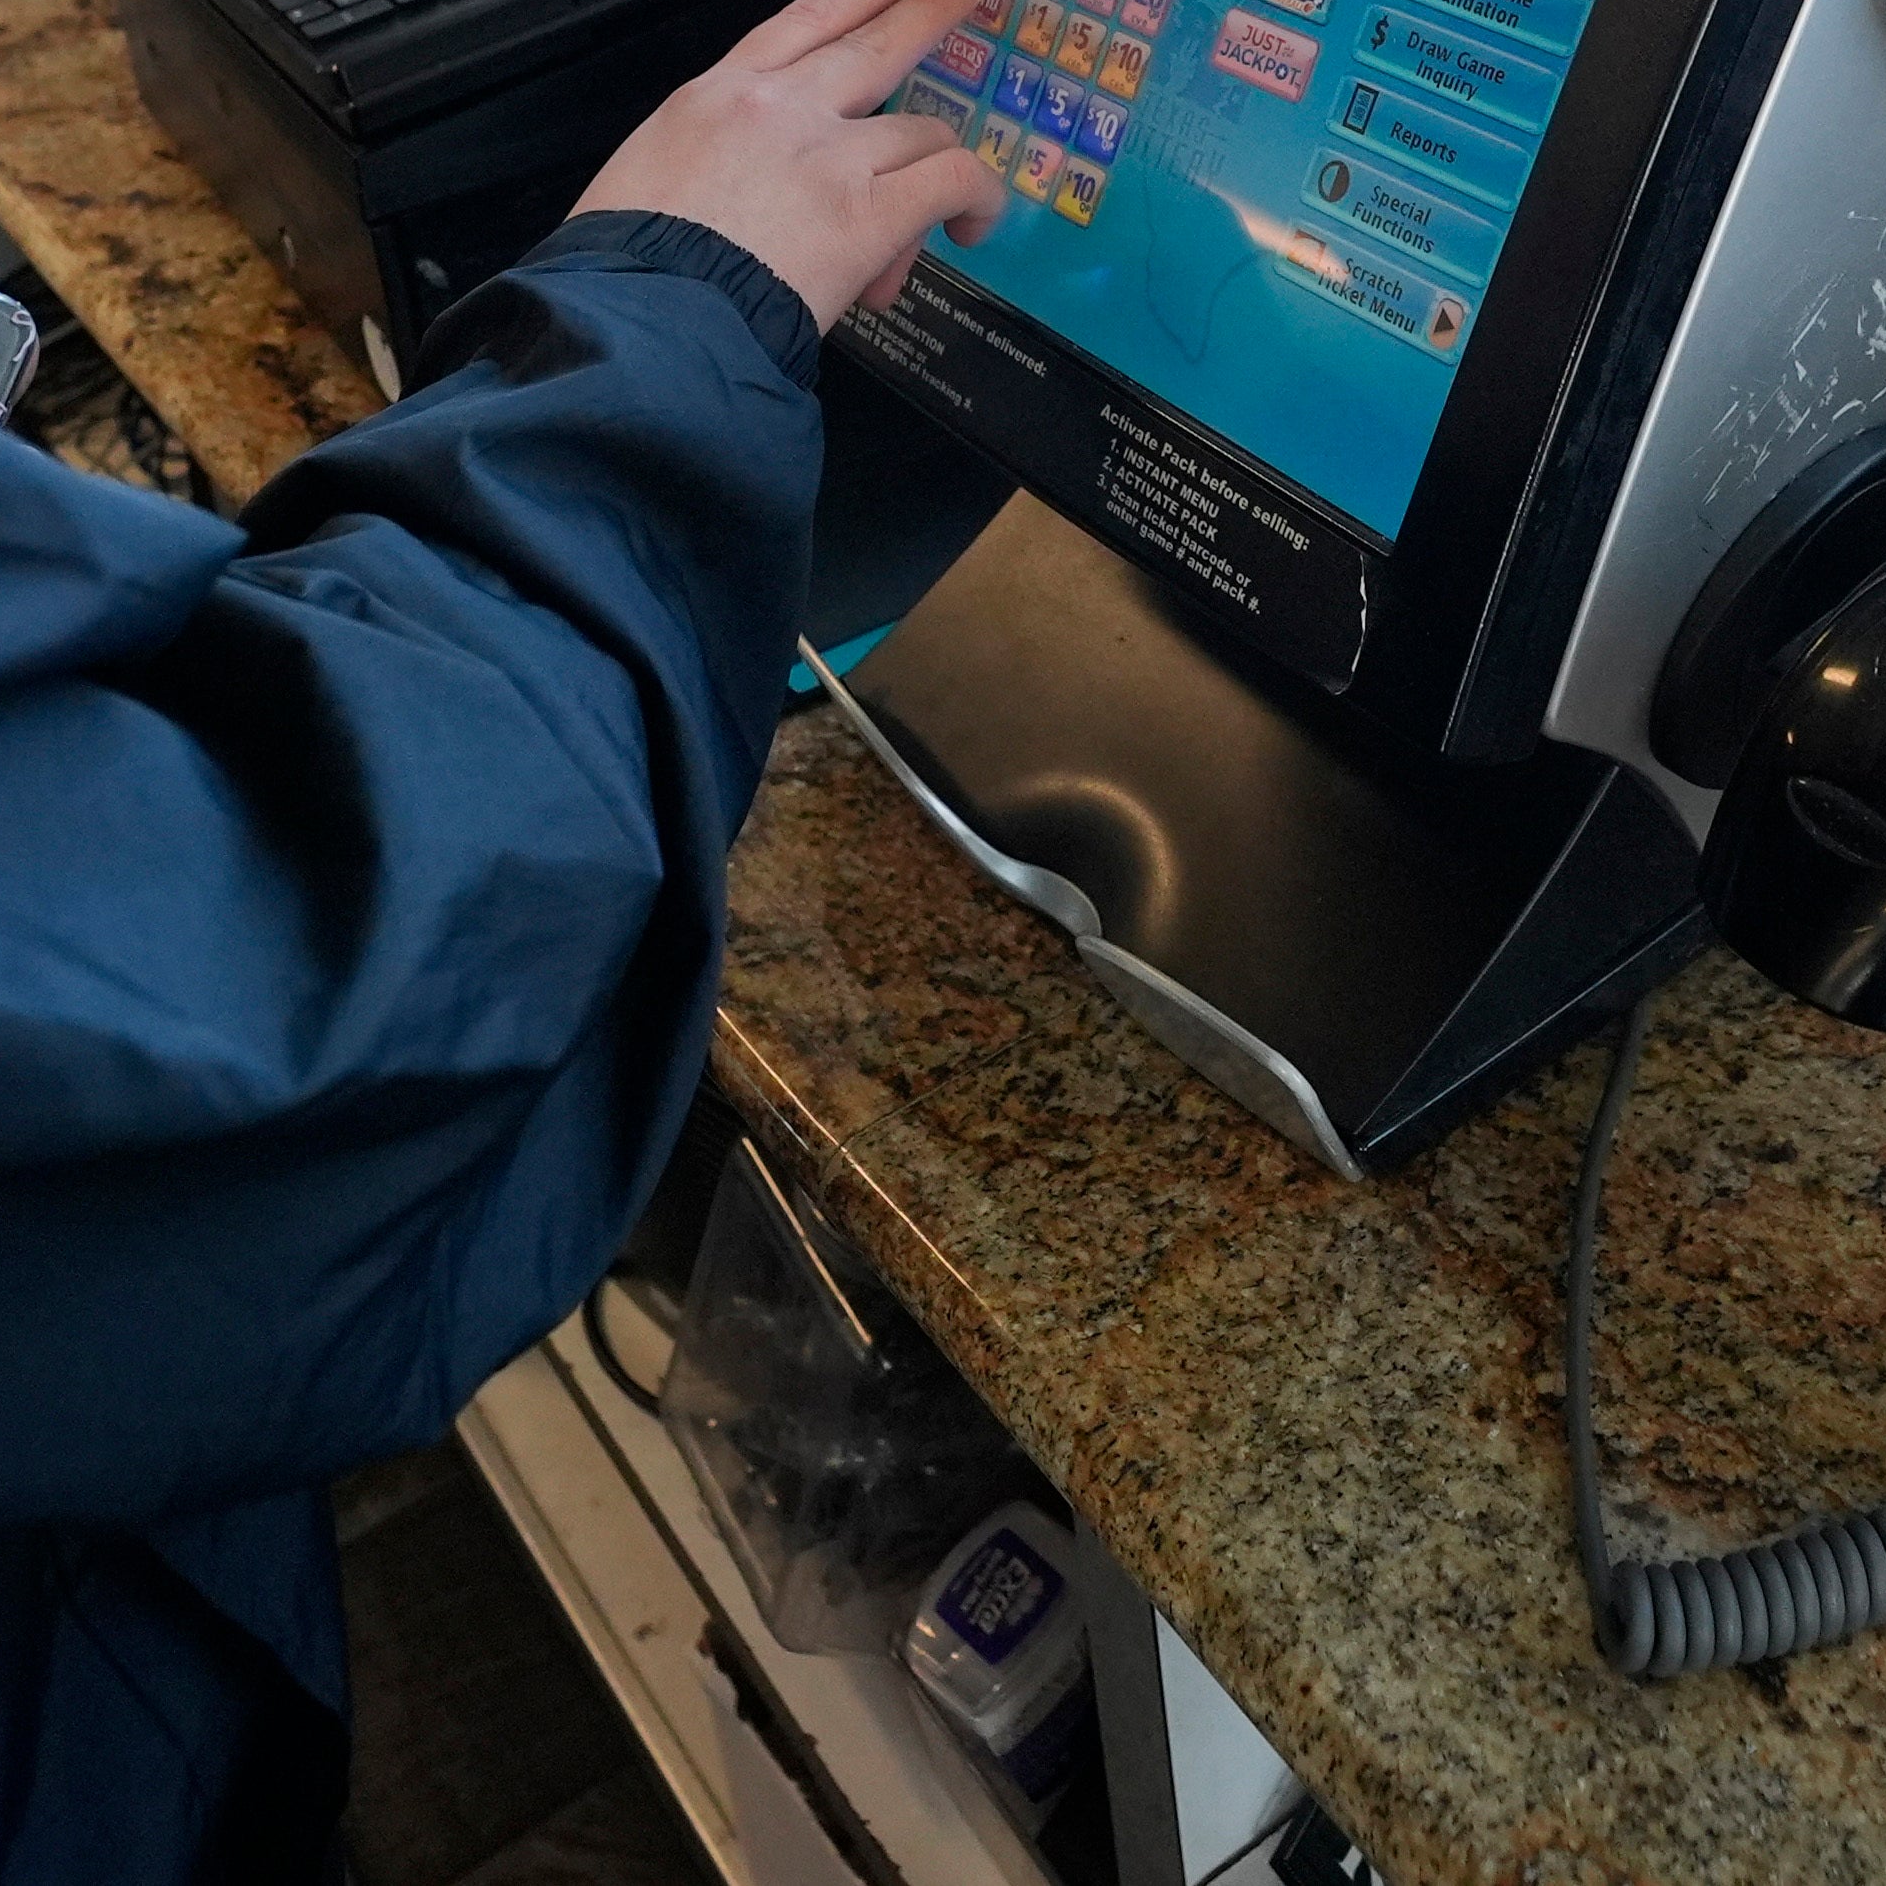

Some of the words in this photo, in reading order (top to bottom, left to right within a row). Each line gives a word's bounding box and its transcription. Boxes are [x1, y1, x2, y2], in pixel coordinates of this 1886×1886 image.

[1031, 3, 1048, 31] $1
[1072, 20, 1092, 50] $5
[1111, 38, 1143, 72] $10
[1241, 24, 1286, 55] JUST
[1406, 30, 1452, 62] Draw
[1456, 51, 1506, 84] Game
[1007, 67, 1025, 96] $1
[1220, 39, 1301, 86] JACKPOT
[1416, 60, 1479, 102] Inquiry
[1048, 86, 1069, 116] $5
[986, 126, 1004, 155] $1
[1087, 107, 1118, 141] $10
[1390, 120, 1458, 164] Reports
[1027, 145, 1047, 177] $5
[1065, 168, 1095, 201] $10
[1371, 185, 1432, 227] Special
[1352, 202, 1435, 254] Functions
[1344, 258, 1404, 302] Scratch
[1318, 273, 1367, 309] Ticket
[1369, 299, 1416, 334] Menu
[911, 278, 951, 315] Tickets
[954, 308, 984, 337] when
[986, 329, 1048, 378] delivered:
[1100, 403, 1159, 452] Activate
[1161, 441, 1198, 477] Pack
[1200, 467, 1250, 510] before
[1251, 505, 1311, 551] selling:
[1110, 437, 1120, 454] 1.
[1122, 446, 1179, 491] INSTANT
[1179, 481, 1220, 519] MENU
[1102, 456, 1113, 473] 2.
[1116, 465, 1178, 516] ACTIVATE
[1180, 508, 1219, 543] PACK
[1096, 474, 1107, 491] 3.
[1110, 483, 1141, 512] Scan
[1143, 504, 1180, 540] ticket
[1181, 531, 1234, 577] barcode
[1236, 573, 1252, 589] or
[1106, 499, 1139, 528] enter
[1140, 521, 1174, 553] game
[1175, 546, 1186, 561] #
[1187, 557, 1211, 579] and
[1213, 570, 1246, 605] pack
[1248, 596, 1261, 615] #.
